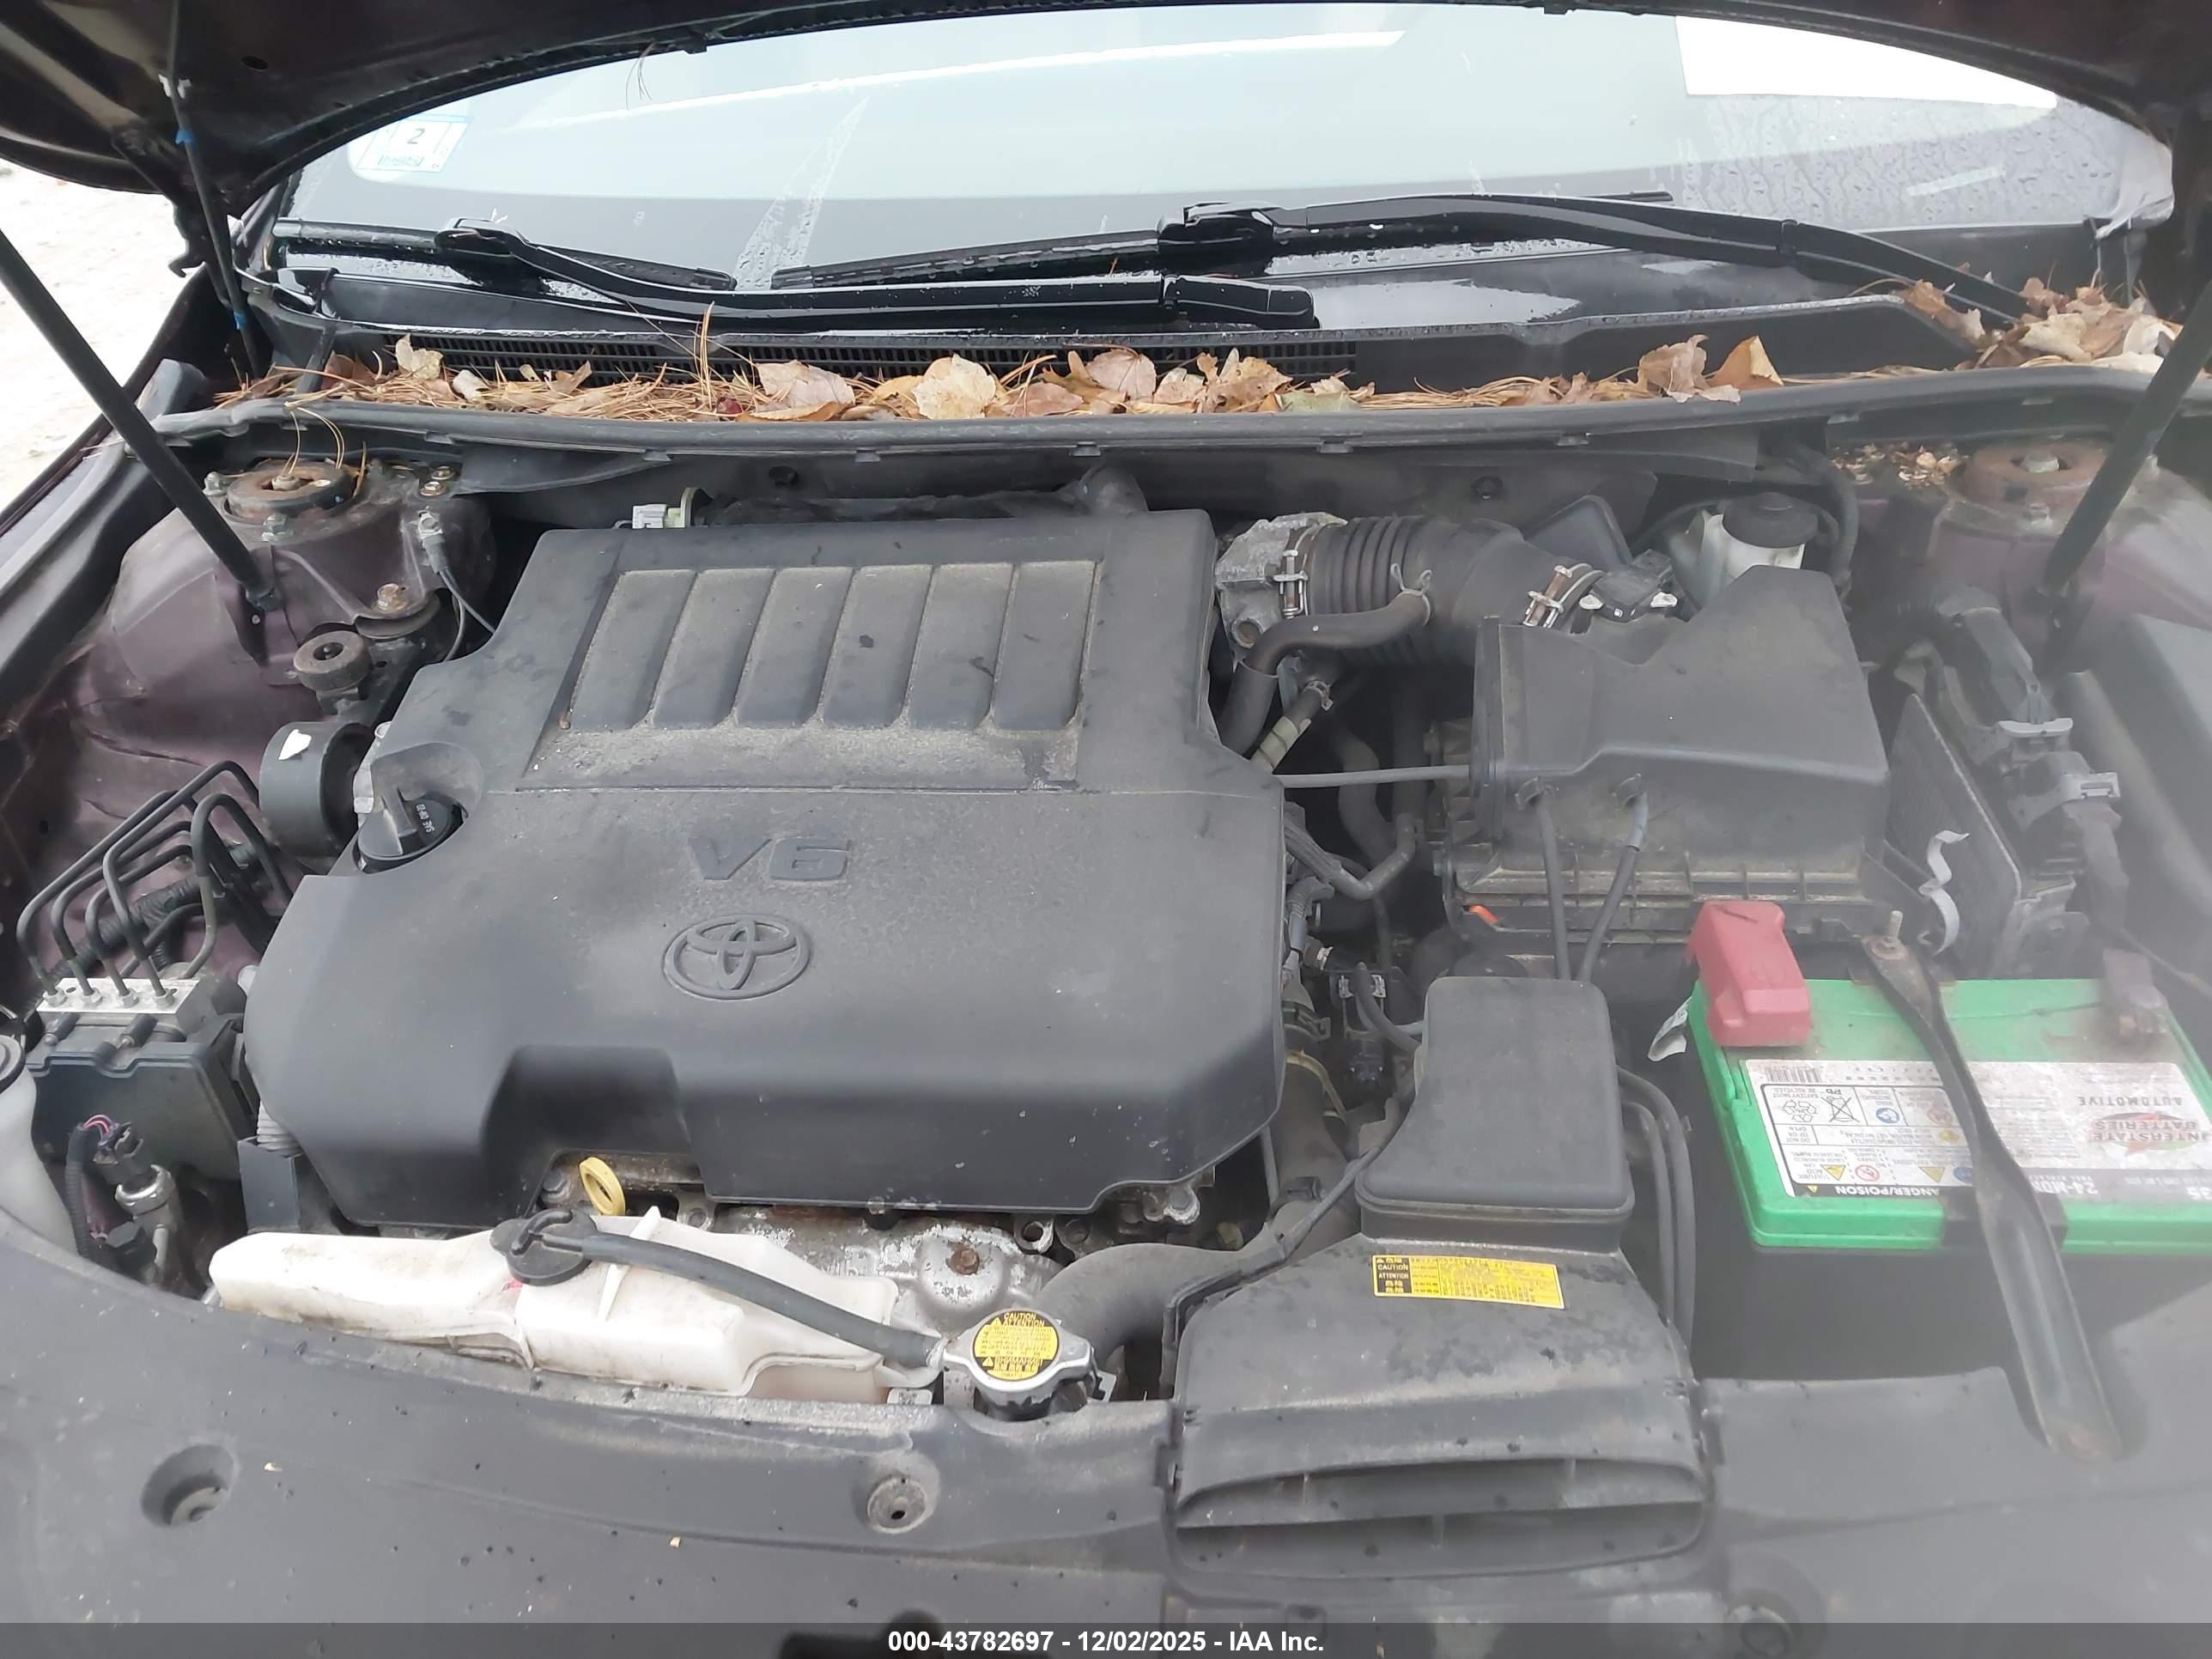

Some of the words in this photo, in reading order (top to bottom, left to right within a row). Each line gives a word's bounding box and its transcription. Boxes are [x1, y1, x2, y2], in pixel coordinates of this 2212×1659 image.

[406, 127, 425, 145] 2
[688, 837, 854, 882] V6
[2077, 1097, 2182, 1107] AUTOMOTIVE
[2094, 1121, 2197, 1131] BATTERIES
[2093, 1132, 2207, 1143] INTERSTATE
[1834, 1185, 1941, 1197] ANGER/POISON
[1002, 1318, 1045, 1328] ATTENTION
